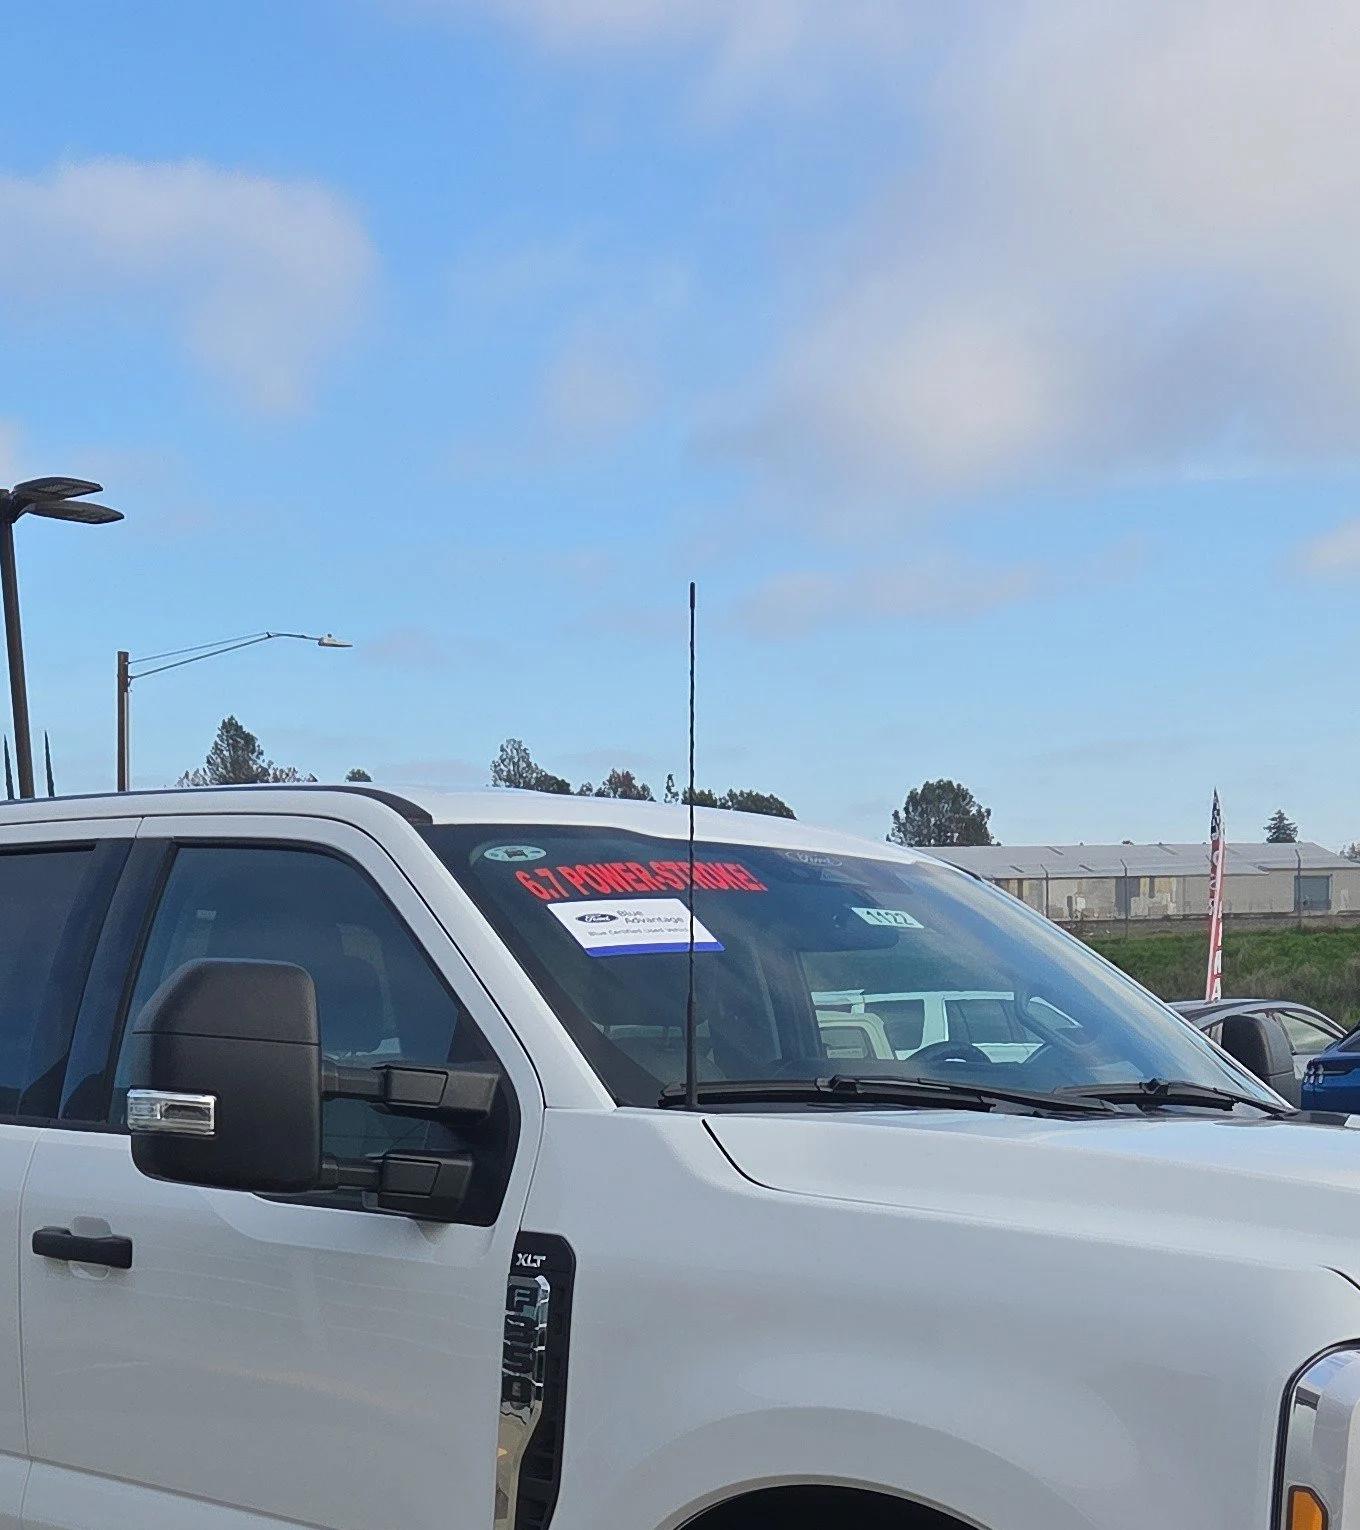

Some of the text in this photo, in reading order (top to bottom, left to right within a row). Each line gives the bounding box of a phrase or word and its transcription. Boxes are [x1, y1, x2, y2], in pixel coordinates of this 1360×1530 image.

[516, 868, 570, 900] 6.7
[866, 910, 915, 926] 1122
[515, 1253, 546, 1268] XLT
